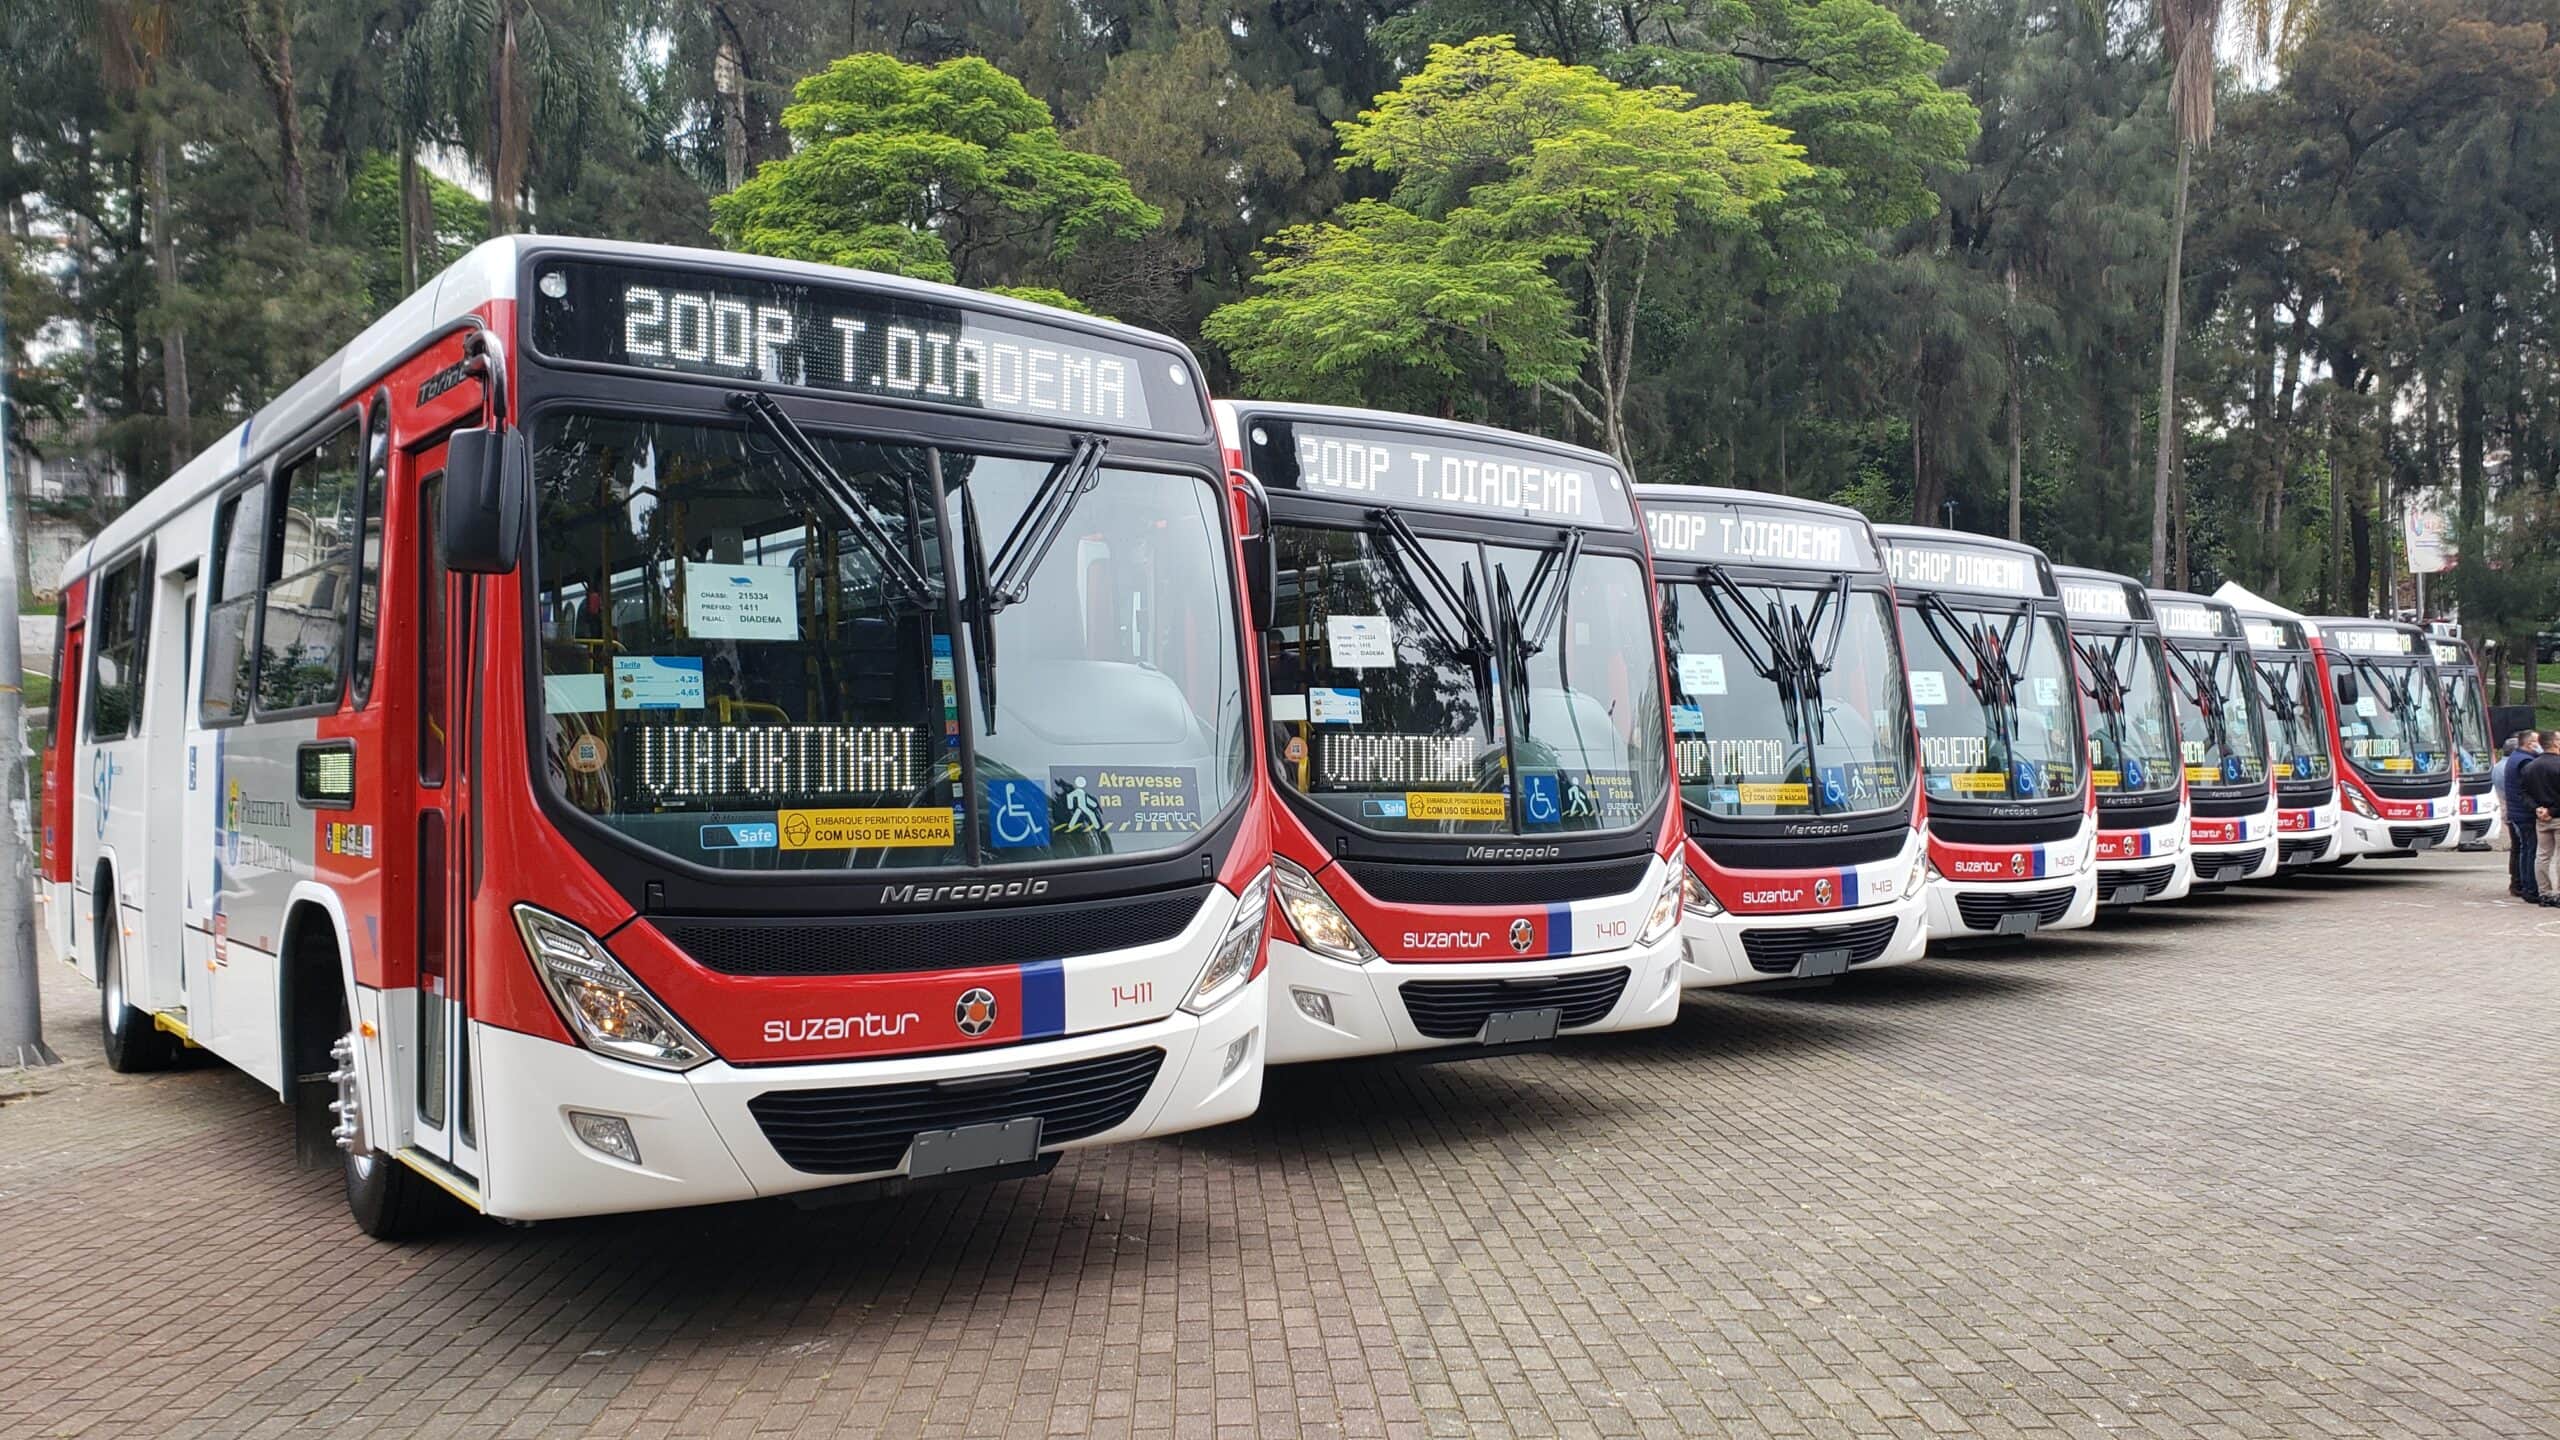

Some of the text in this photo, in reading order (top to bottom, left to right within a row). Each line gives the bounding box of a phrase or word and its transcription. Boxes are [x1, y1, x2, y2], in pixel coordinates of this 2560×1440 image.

[1908, 551, 1951, 584] SHOP
[739, 604, 759, 612] 1411
[739, 615, 783, 624] DIADEMA
[1098, 771, 1182, 788] Atravesse
[1100, 791, 1185, 808] na Faixa
[1608, 787, 1634, 800] Faixa
[1134, 811, 1197, 822] suzantur
[1426, 806, 1443, 815] COM
[815, 815, 950, 826] EMBARQUE PERMITIDO SOMENTE
[738, 828, 773, 843] Safe
[815, 826, 951, 842] COM USO DE MÁSCARA
[1783, 822, 1849, 837] Marcopolo
[1466, 844, 1560, 861] Marcopolo
[1955, 860, 2003, 874] suzantur
[880, 877, 1049, 905] Marcopolo
[1871, 879, 1893, 895] 1413
[1743, 888, 1804, 904] suzantur
[1596, 919, 1627, 938] 1410
[1403, 930, 1491, 948] suzantur
[1111, 981, 1153, 1009] 1411
[763, 1011, 920, 1044] suzantur
